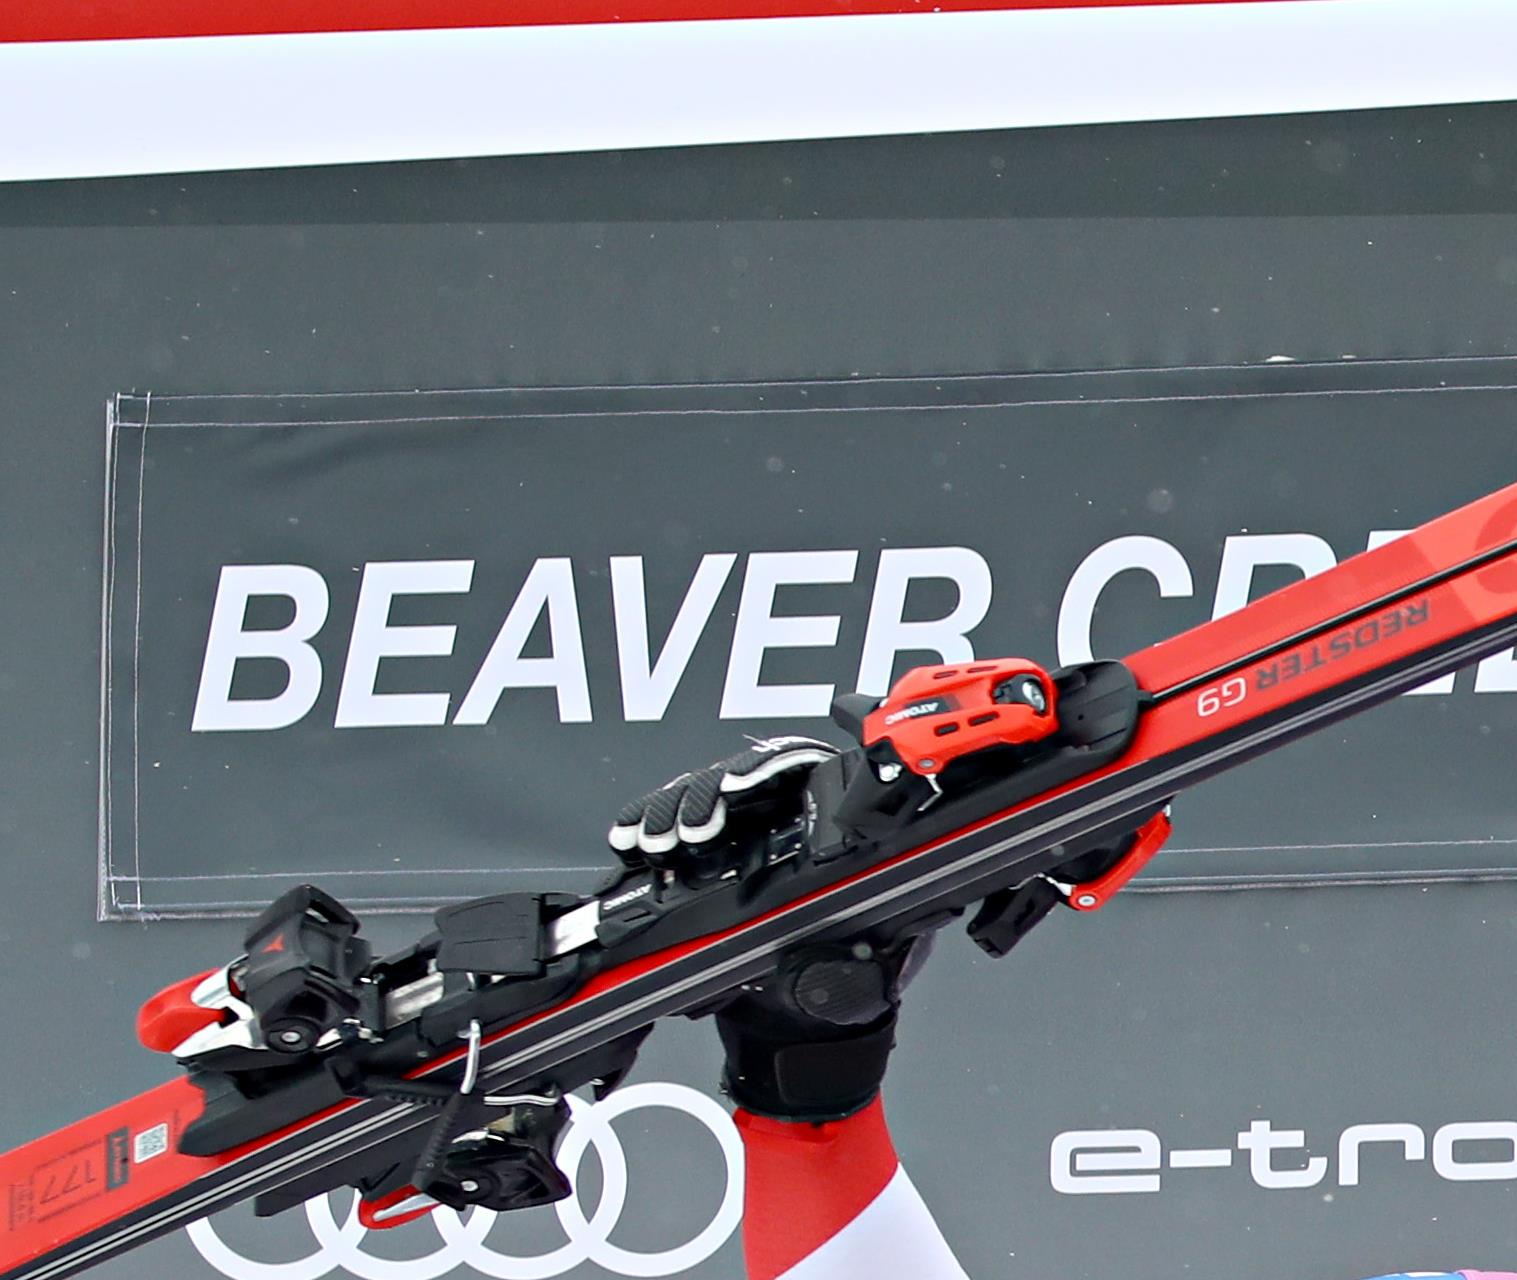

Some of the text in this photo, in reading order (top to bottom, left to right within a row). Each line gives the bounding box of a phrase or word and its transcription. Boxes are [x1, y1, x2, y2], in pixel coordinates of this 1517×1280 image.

[191, 545, 995, 732] BEAVER
[1197, 598, 1430, 718] REDSTER G9
